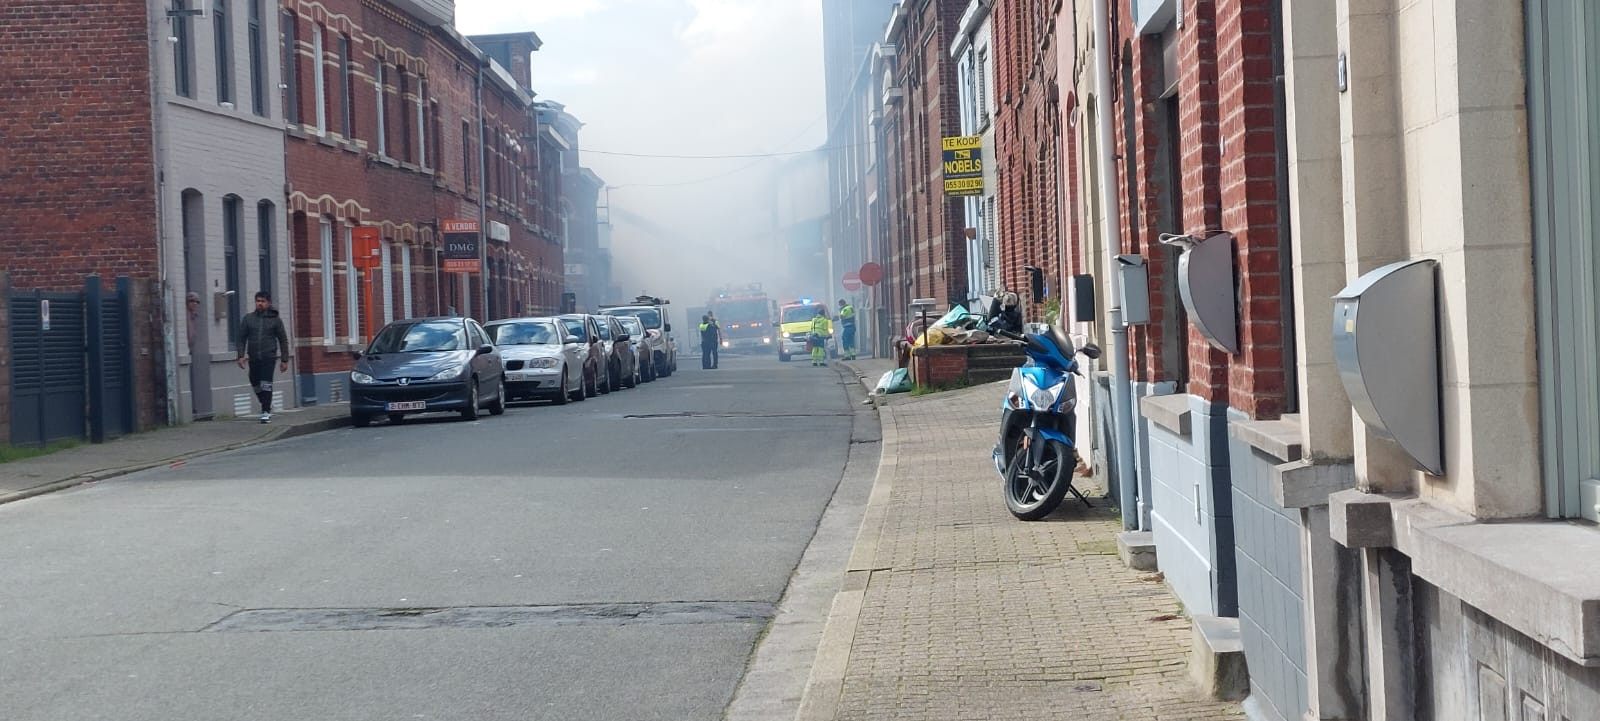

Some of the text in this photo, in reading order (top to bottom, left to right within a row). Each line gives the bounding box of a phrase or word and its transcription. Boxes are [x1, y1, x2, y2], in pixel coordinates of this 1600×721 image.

[944, 137, 979, 147] TE KOOP
[944, 159, 982, 174] NOBELS
[445, 222, 477, 231] A VENDRE
[449, 243, 474, 251] DMG
